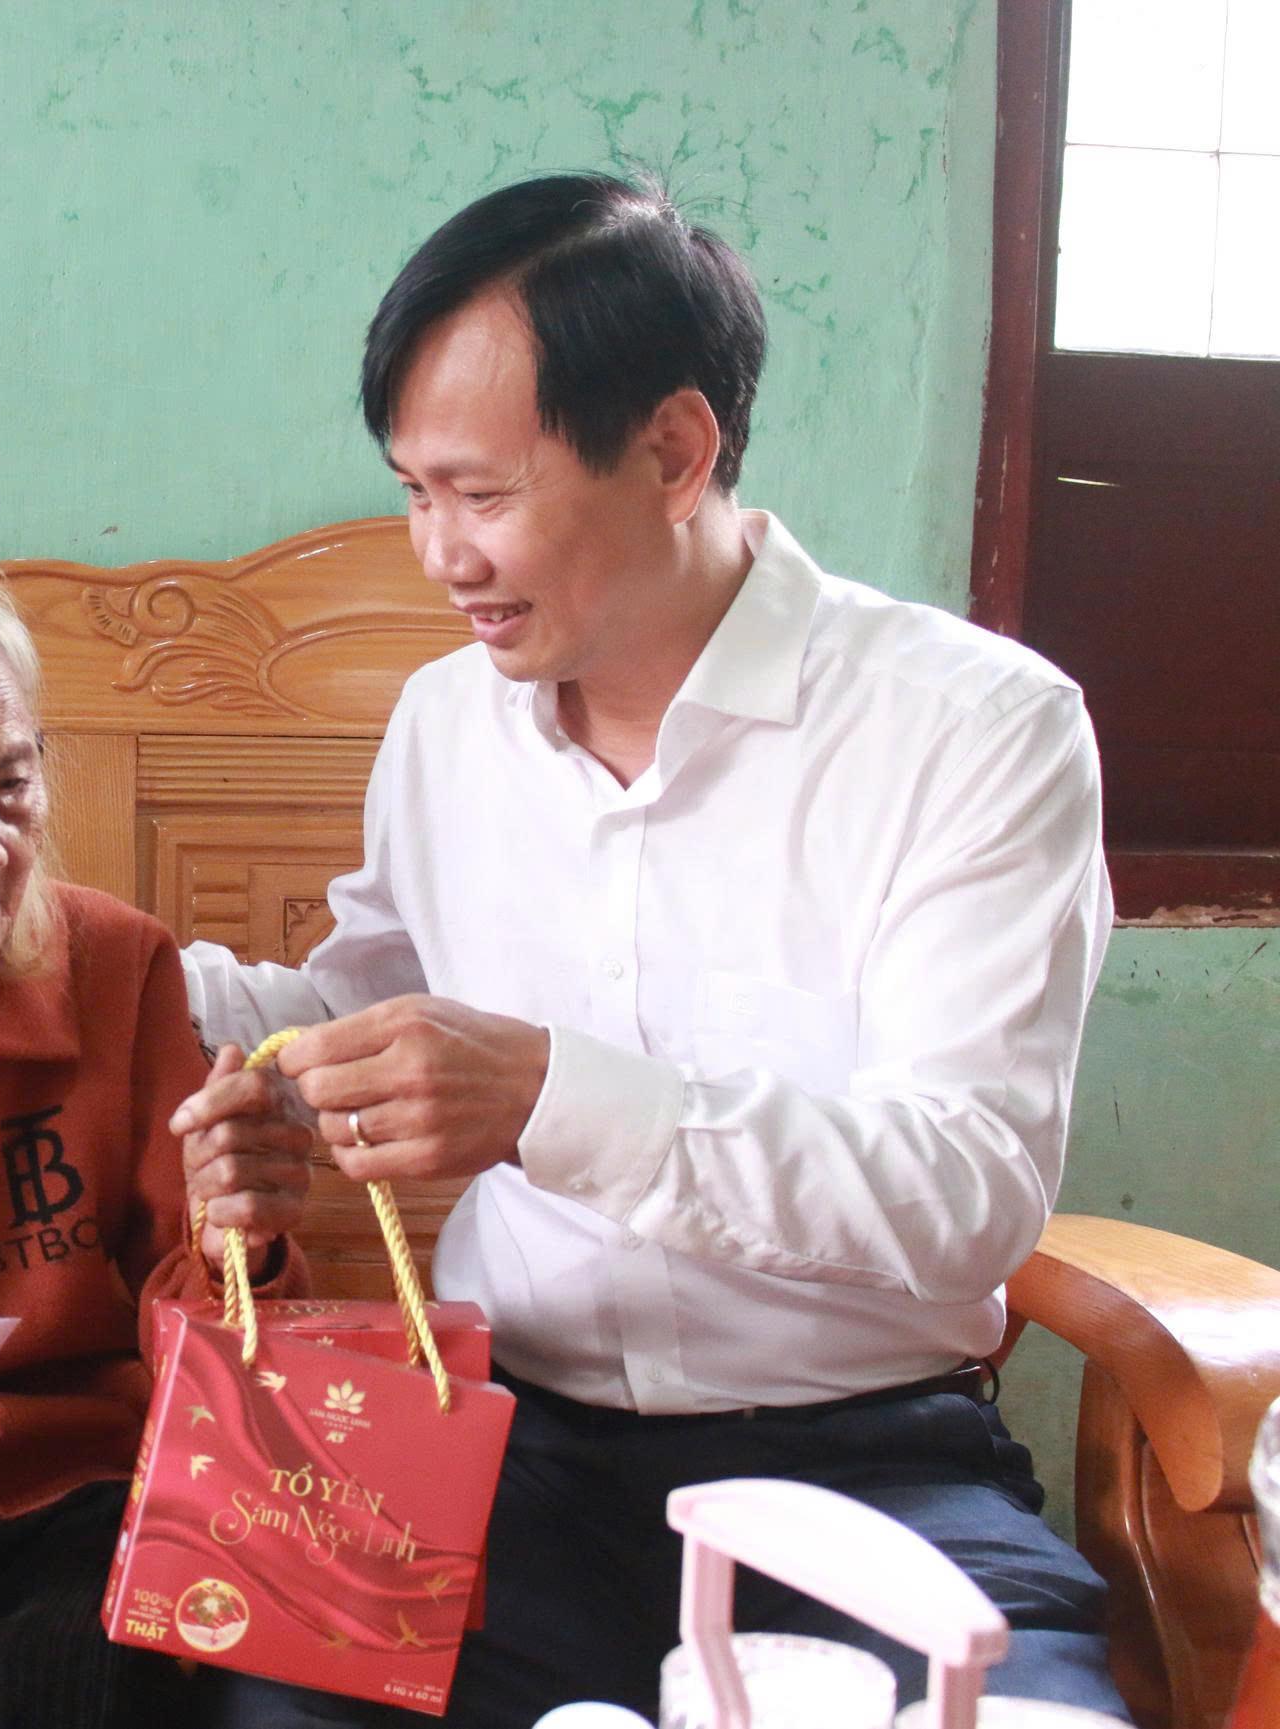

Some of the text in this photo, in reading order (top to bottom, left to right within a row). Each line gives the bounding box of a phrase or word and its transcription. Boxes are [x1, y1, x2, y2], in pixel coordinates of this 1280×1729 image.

[270, 1462, 314, 1497] TỔ
[209, 1489, 289, 1546] Sâm
[125, 1618, 169, 1642] THẬT
